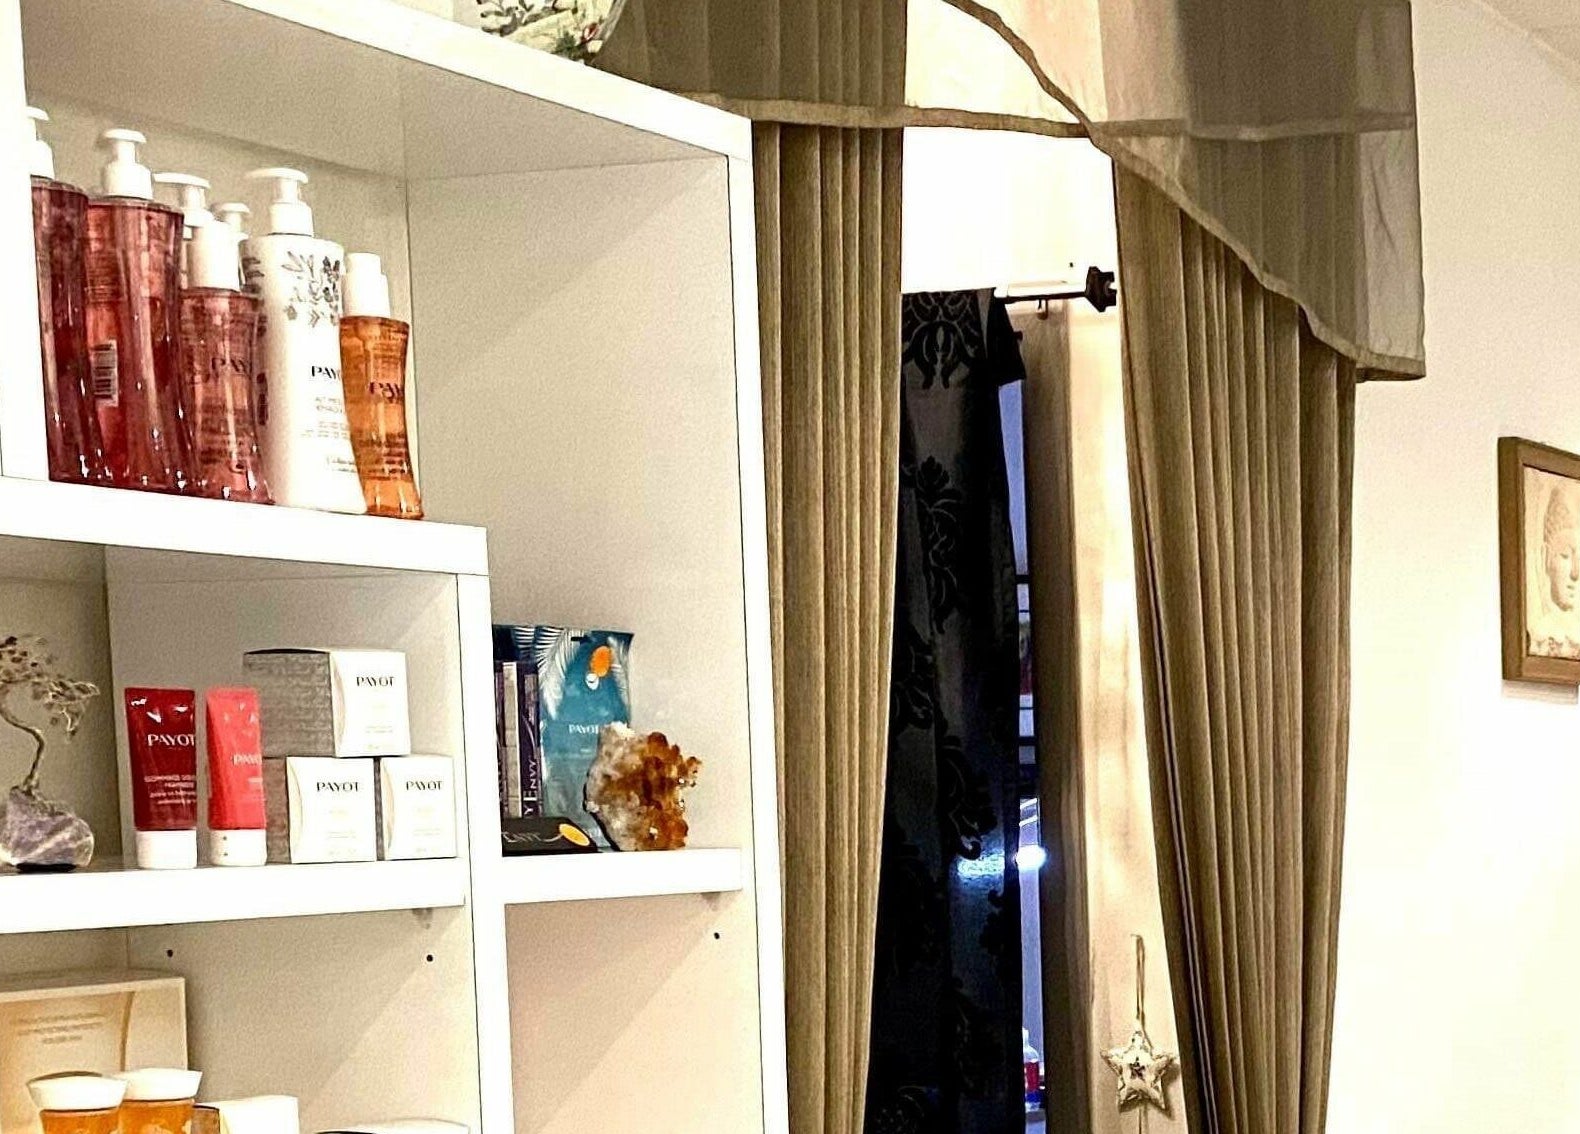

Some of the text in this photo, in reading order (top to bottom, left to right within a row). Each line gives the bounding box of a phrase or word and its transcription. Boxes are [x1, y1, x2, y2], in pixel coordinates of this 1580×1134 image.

[355, 676, 396, 687] PAYOT
[316, 781, 361, 793] PAYOT
[405, 780, 444, 791] PAYOT
